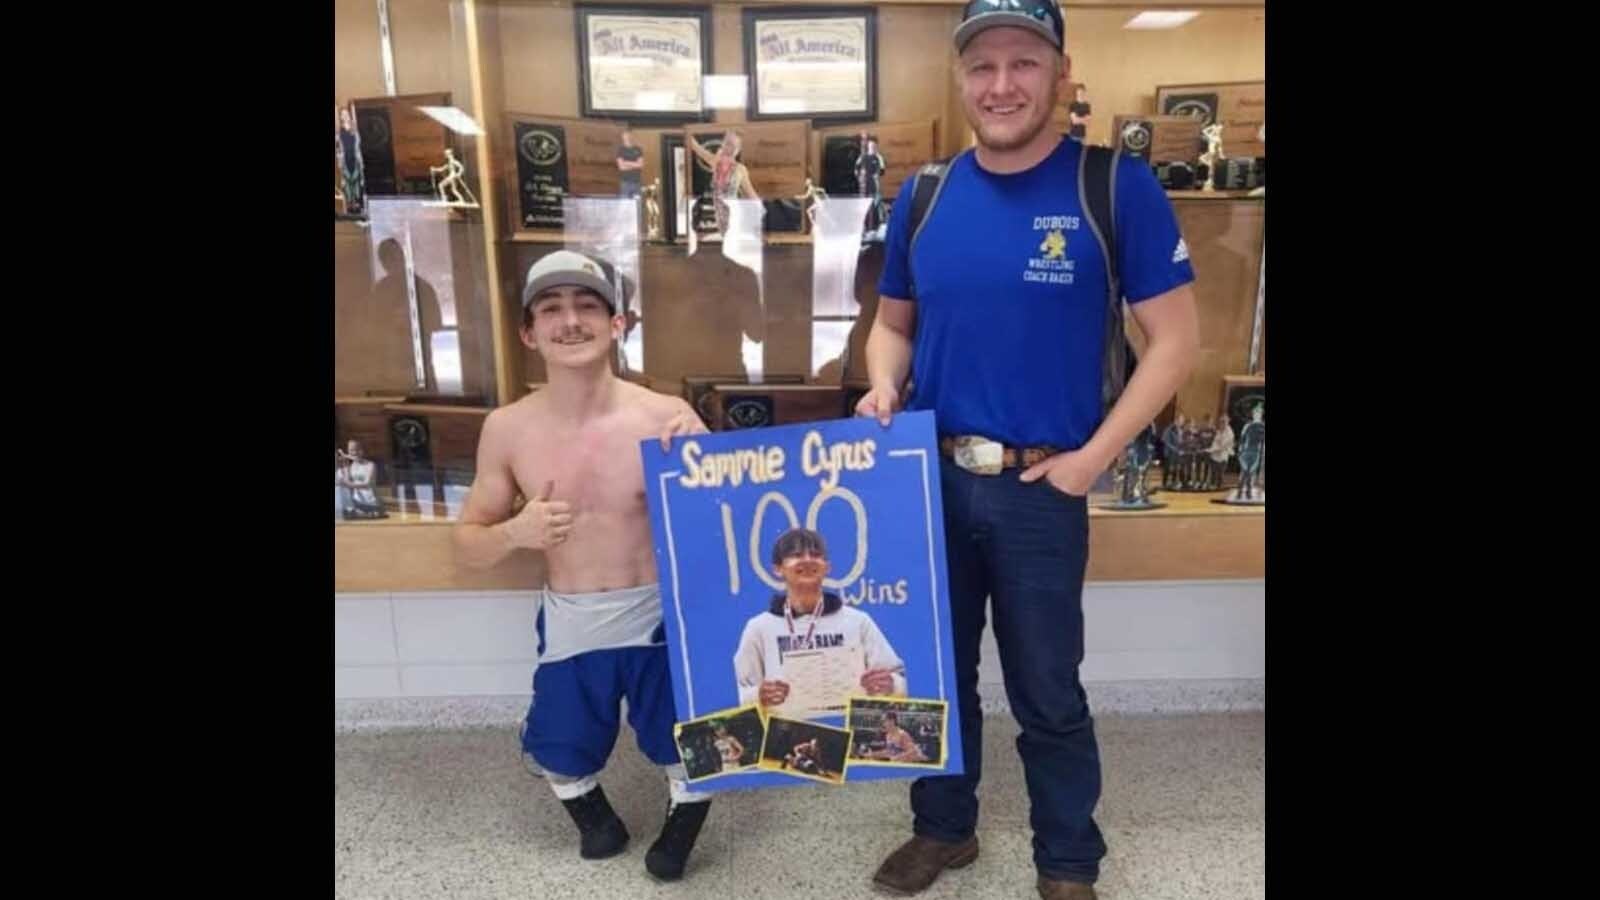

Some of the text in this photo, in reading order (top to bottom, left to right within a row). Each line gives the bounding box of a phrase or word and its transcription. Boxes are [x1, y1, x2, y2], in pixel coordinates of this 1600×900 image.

[1033, 216, 1080, 230] DUBOIS
[1028, 258, 1075, 270] WRESTLING
[680, 430, 877, 490] Sammie Cyrus
[720, 486, 869, 595] 100
